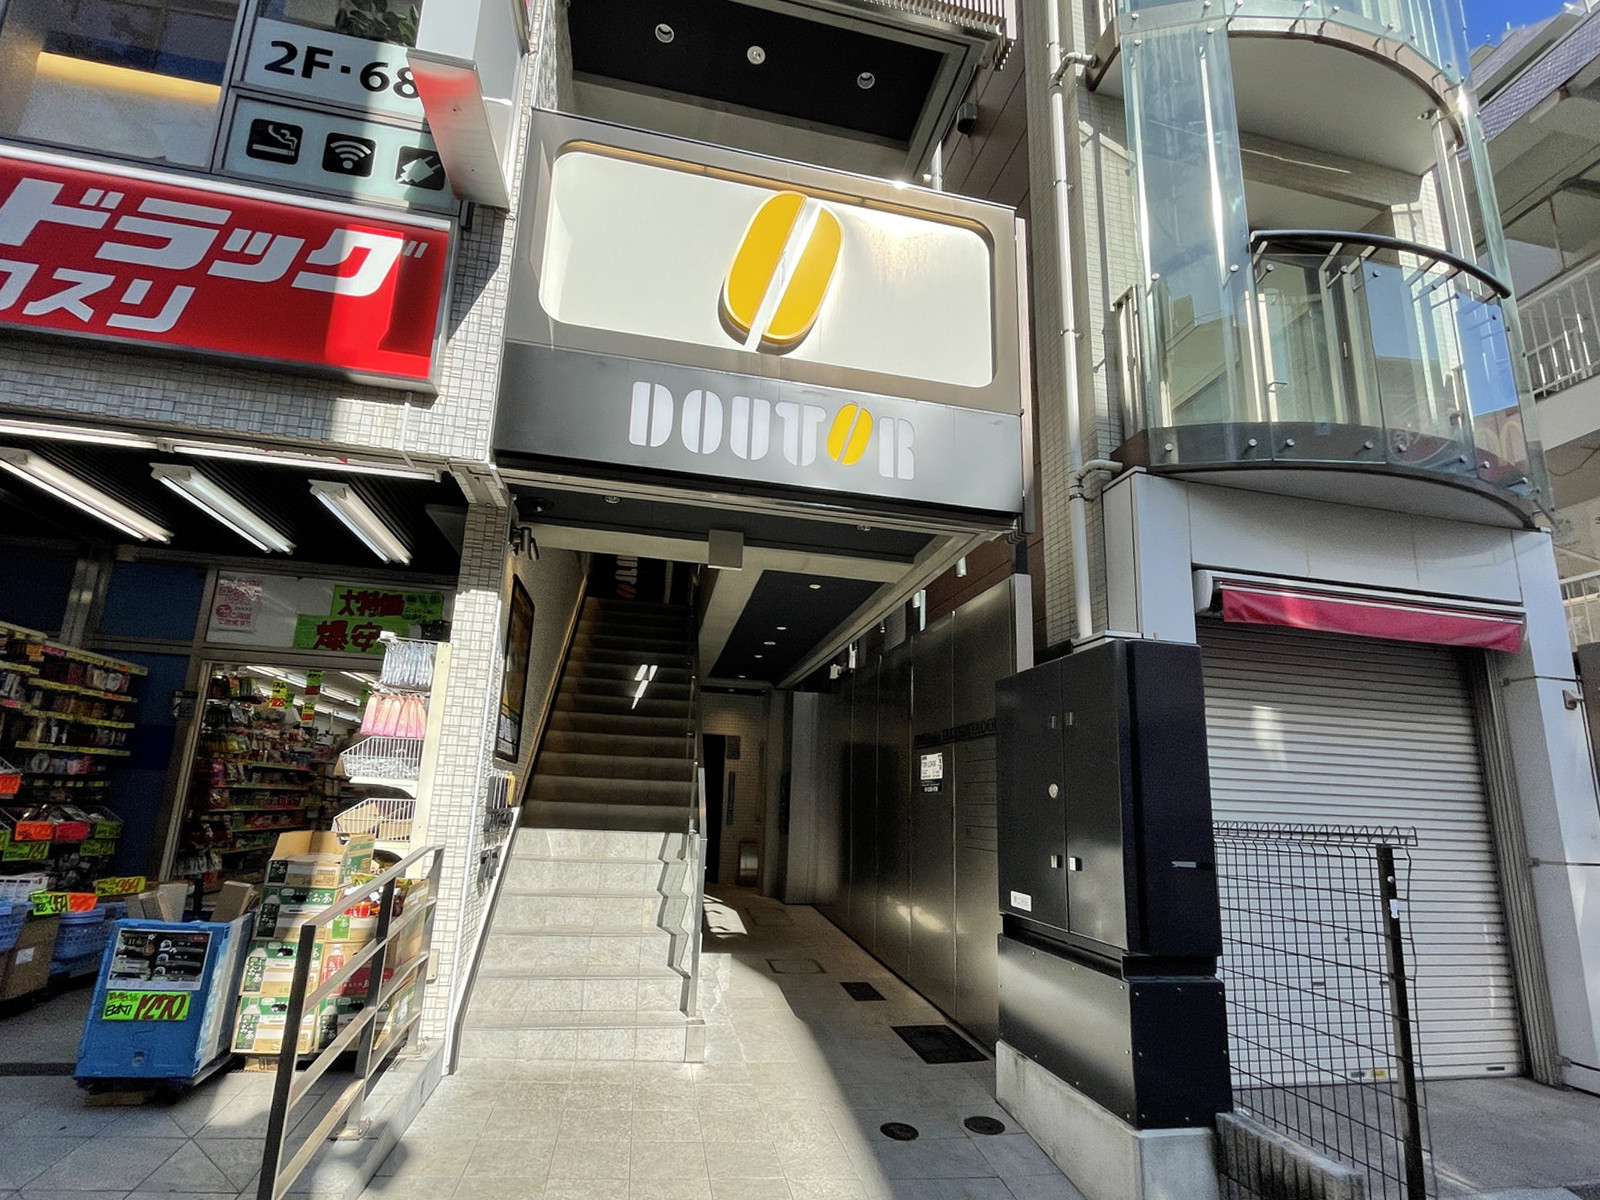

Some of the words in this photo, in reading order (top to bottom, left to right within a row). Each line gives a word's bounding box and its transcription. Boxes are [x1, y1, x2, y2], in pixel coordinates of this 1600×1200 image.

[0, 177, 429, 297] ドラッグ
[628, 380, 916, 481] DOUTOR
